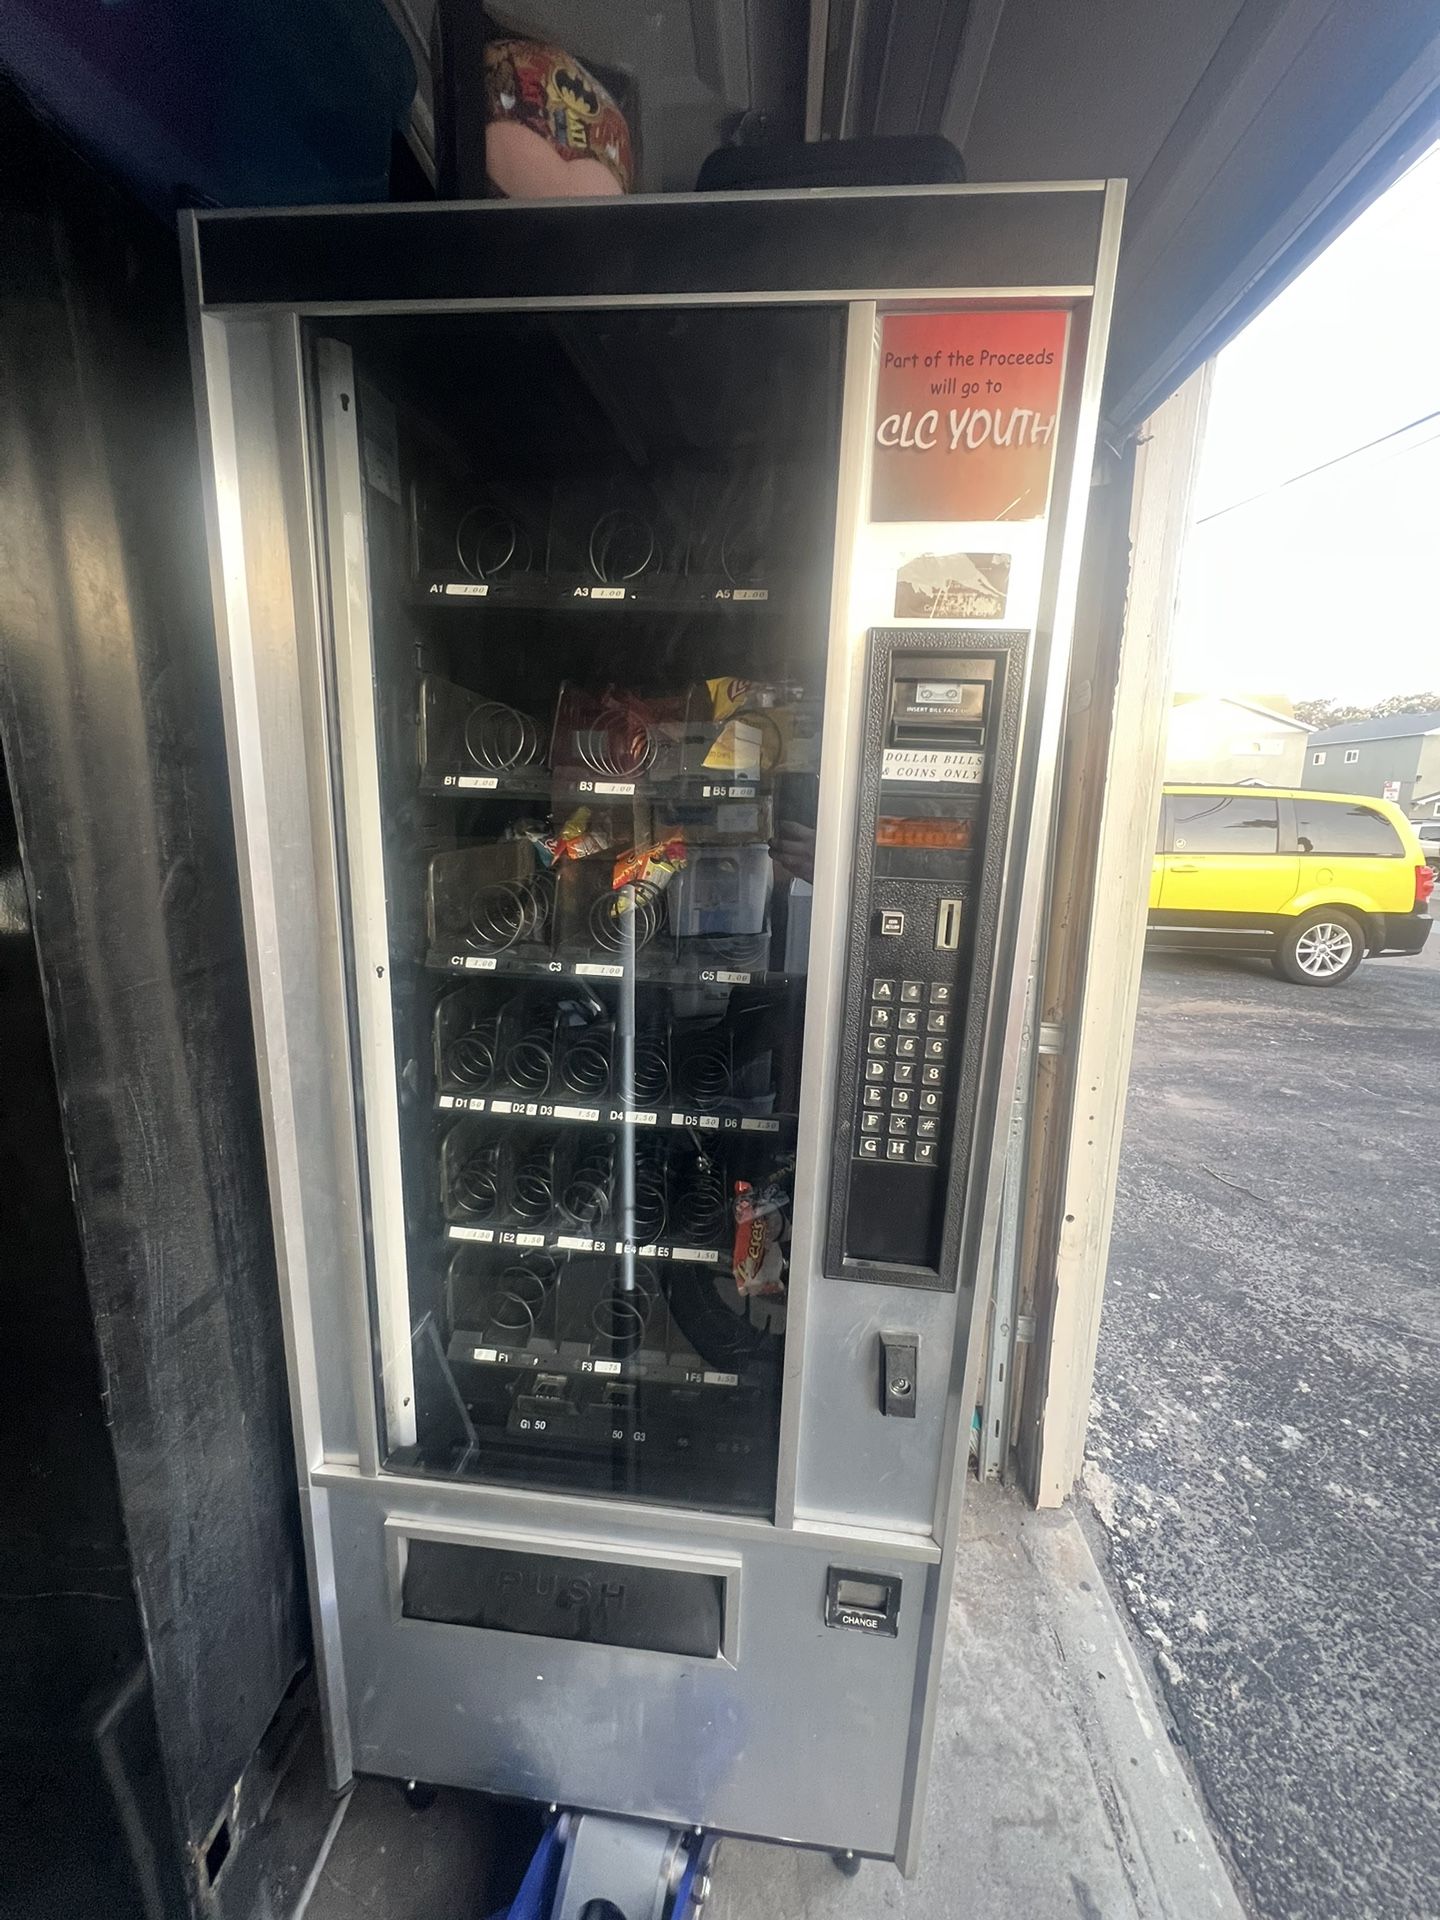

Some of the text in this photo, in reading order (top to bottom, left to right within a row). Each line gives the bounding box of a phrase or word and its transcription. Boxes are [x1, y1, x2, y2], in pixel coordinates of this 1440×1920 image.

[885, 348, 1054, 369] Part of the Proceeds
[930, 378, 1002, 399] will go to
[876, 407, 1056, 450] CLC YOUTH
[430, 583, 444, 593] A1
[573, 586, 589, 597] A3
[715, 589, 731, 599] A5
[929, 706, 942, 714] BILL
[885, 752, 983, 766] DOLLAR BILLS
[896, 767, 937, 778] COINS
[944, 768, 981, 780] ONLY
[444, 776, 457, 786] B1
[579, 781, 593, 792] B3
[712, 786, 727, 796] B5
[451, 955, 464, 966] C1
[548, 961, 562, 972] C3
[701, 970, 715, 981] C5
[878, 983, 891, 995] A
[937, 987, 948, 999] 2
[877, 1010, 945, 1026] B 3 4
[873, 1036, 943, 1053] C 5 6
[871, 1063, 939, 1080] D 7 8
[869, 1088, 936, 1105] E 9 0
[455, 1097, 468, 1108] D1
[512, 1103, 526, 1114] D2
[540, 1105, 553, 1116] D3
[609, 1110, 624, 1121] D4
[685, 1115, 698, 1126] D5
[867, 1114, 879, 1126] F
[724, 1118, 738, 1128] D6
[864, 1140, 931, 1157] G H J
[503, 1232, 516, 1243] E2
[593, 1241, 606, 1252] E3
[623, 1244, 637, 1255] E4
[657, 1246, 670, 1257] E5
[581, 1361, 593, 1372] F3
[534, 1420, 547, 1430] 50
[612, 1430, 646, 1442] 50 G3
[497, 1569, 626, 1609] PUSH
[842, 1615, 879, 1629] CHANGE
